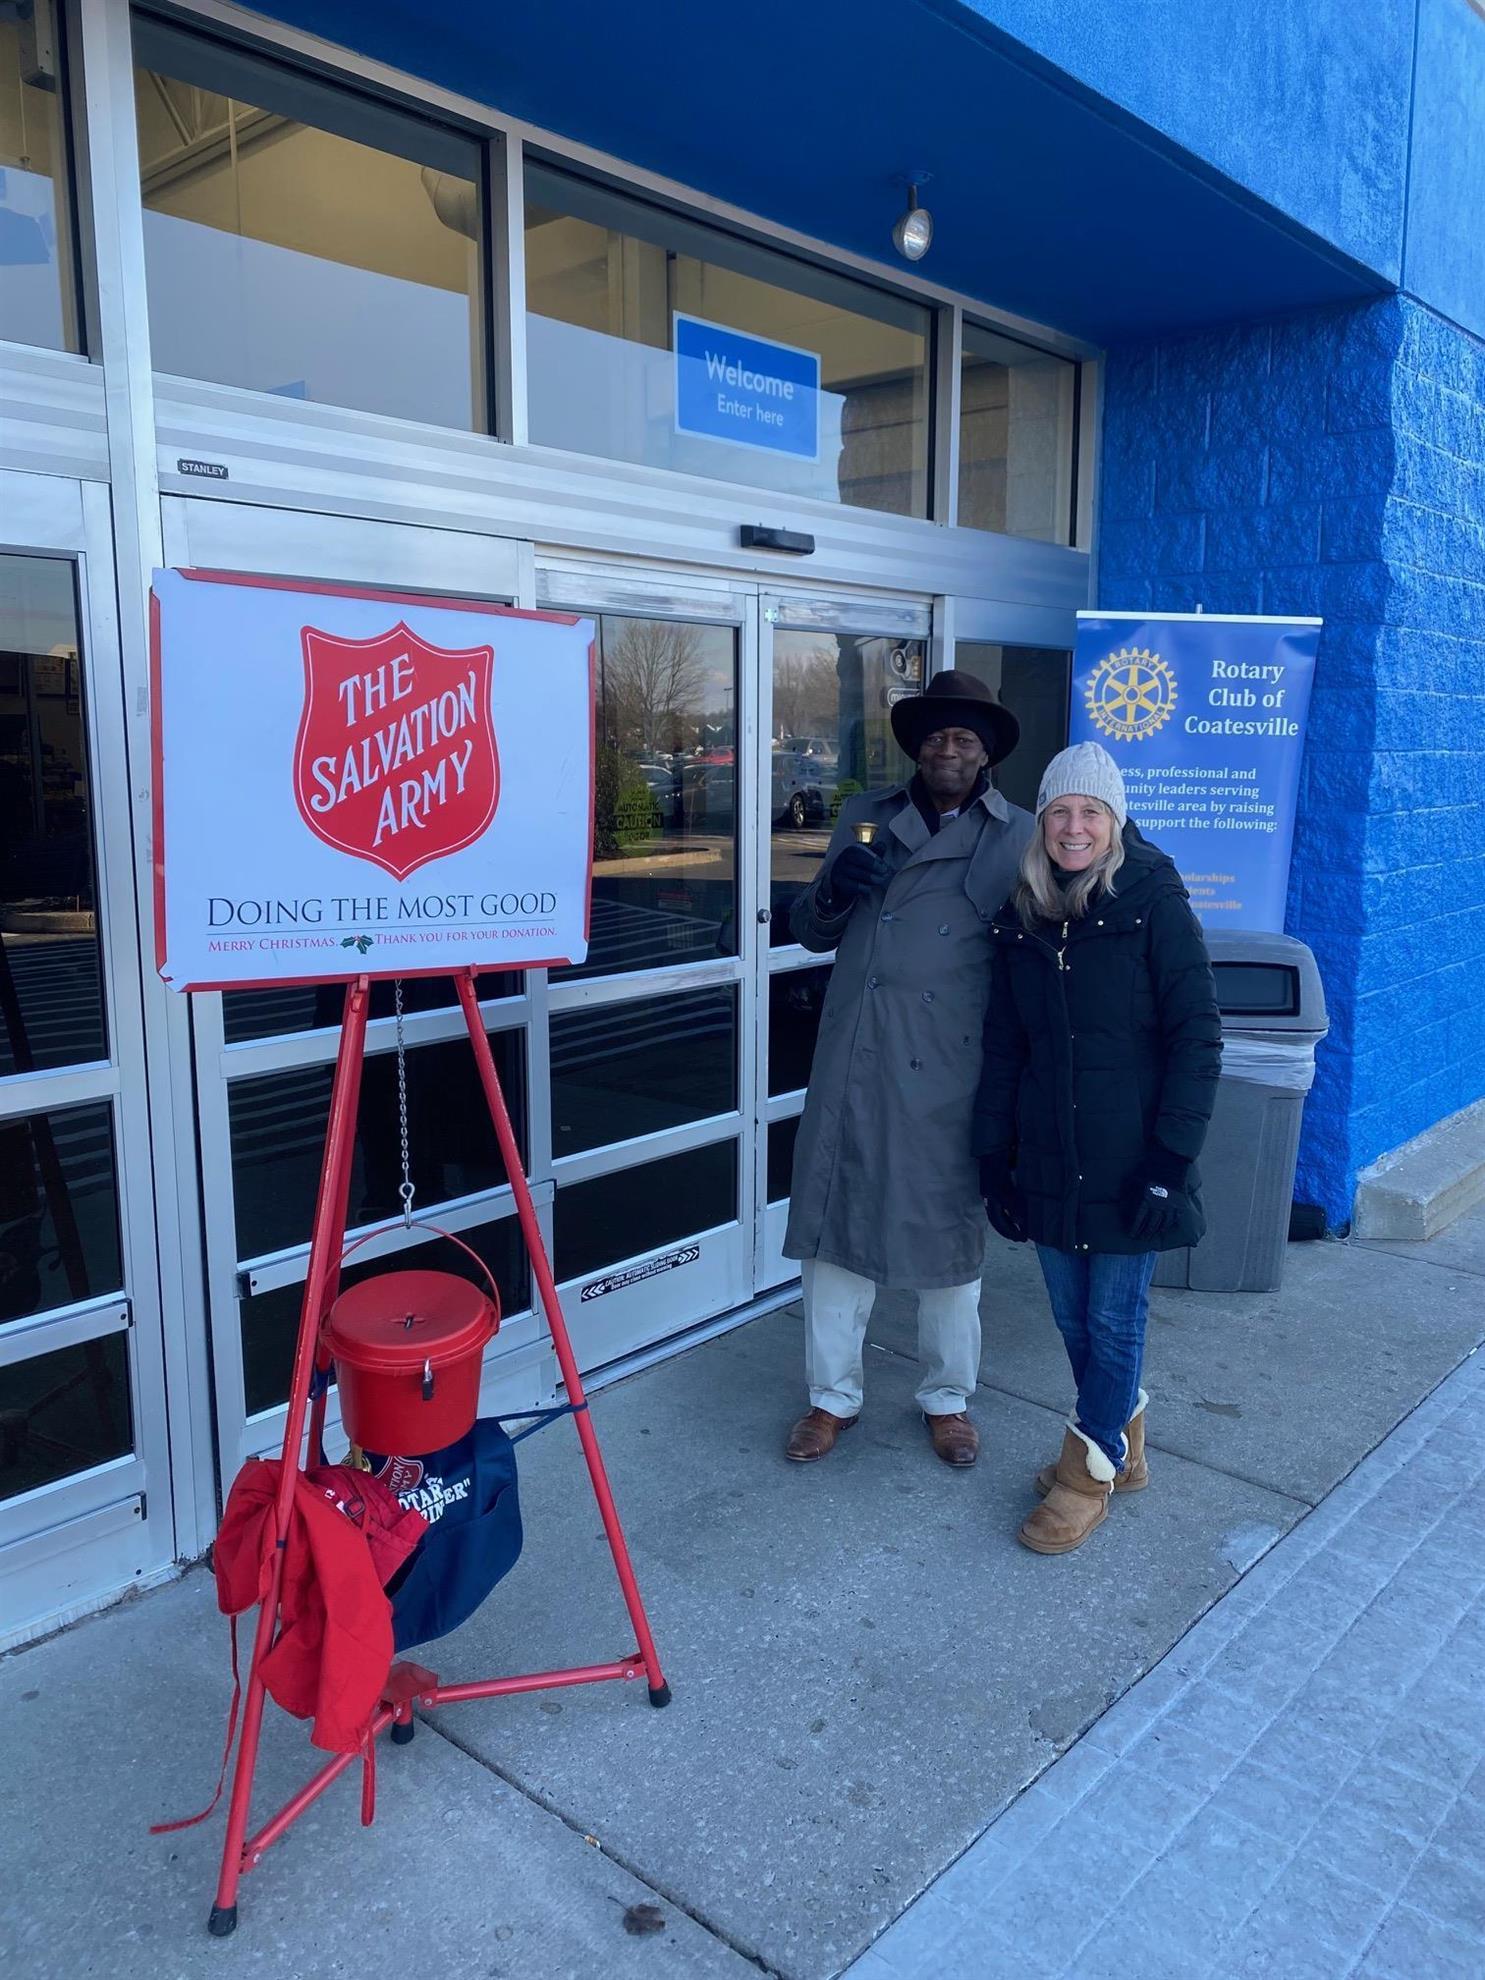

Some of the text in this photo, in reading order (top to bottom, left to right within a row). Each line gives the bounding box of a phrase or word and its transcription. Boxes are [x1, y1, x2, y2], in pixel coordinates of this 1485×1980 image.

[704, 349, 795, 401] Welcome
[717, 392, 785, 427] Enter here
[181, 461, 226, 477] STANLEY
[1211, 659, 1286, 685] Rotary
[338, 652, 416, 727] THE
[1208, 687, 1286, 708] Club of
[1184, 715, 1300, 737] Coatesville
[309, 670, 478, 813] SALVATION
[1120, 766, 1257, 780] ess, professional and
[372, 738, 473, 848] ARMY
[1159, 783, 1207, 796] leaders
[1210, 785, 1260, 799] serving
[1178, 803, 1207, 813] area
[1211, 801, 1228, 815] by
[1229, 803, 1275, 817] raising
[1135, 817, 1278, 833] support the following:
[208, 892, 557, 927] DOING THE MOST GOOD
[208, 927, 558, 952] MERRY CHRISTMAS. THANK YOU FOR YOUR DONATION.
